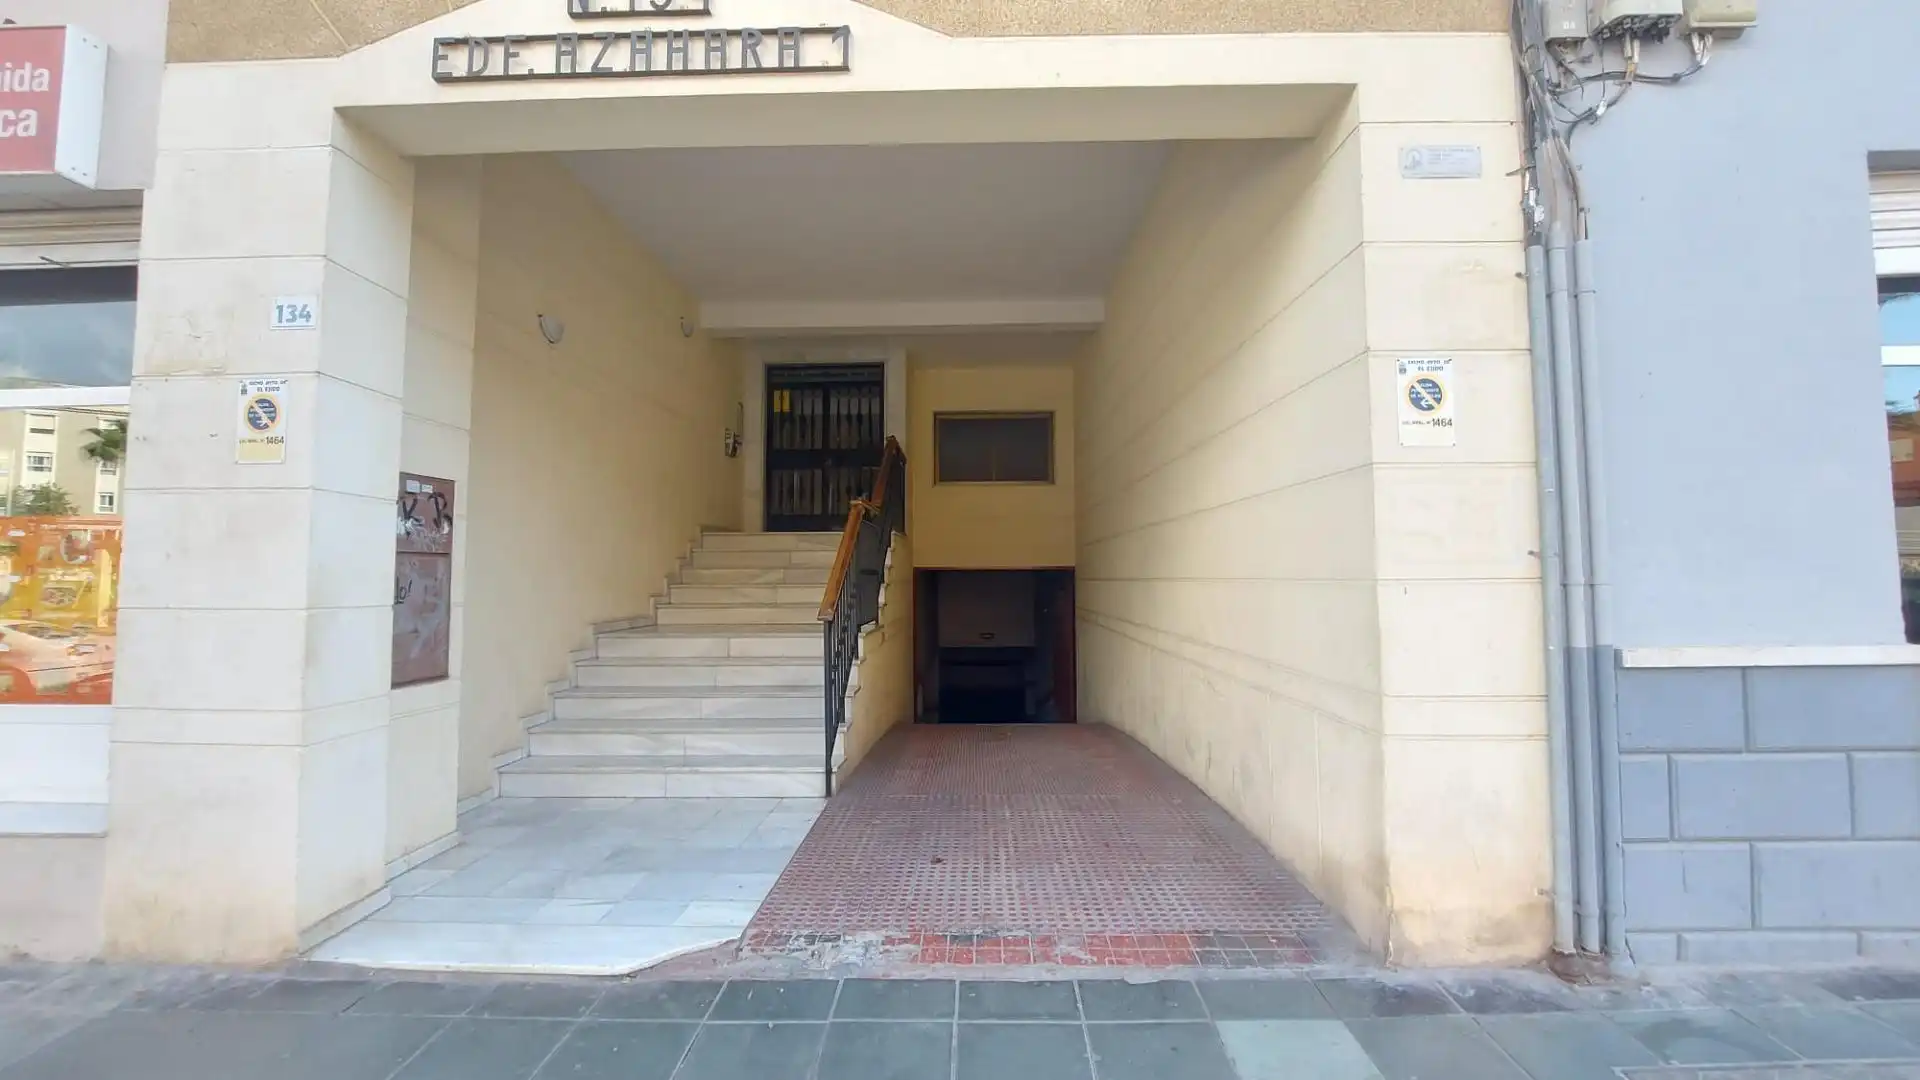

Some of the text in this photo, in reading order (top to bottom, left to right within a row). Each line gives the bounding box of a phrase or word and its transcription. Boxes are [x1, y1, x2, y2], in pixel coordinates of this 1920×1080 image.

[555, 27, 801, 74] AZAHARA
[0, 62, 50, 92] ida
[275, 304, 312, 324] 134
[1431, 417, 1453, 428] 1464
[265, 436, 285, 445] 1464
